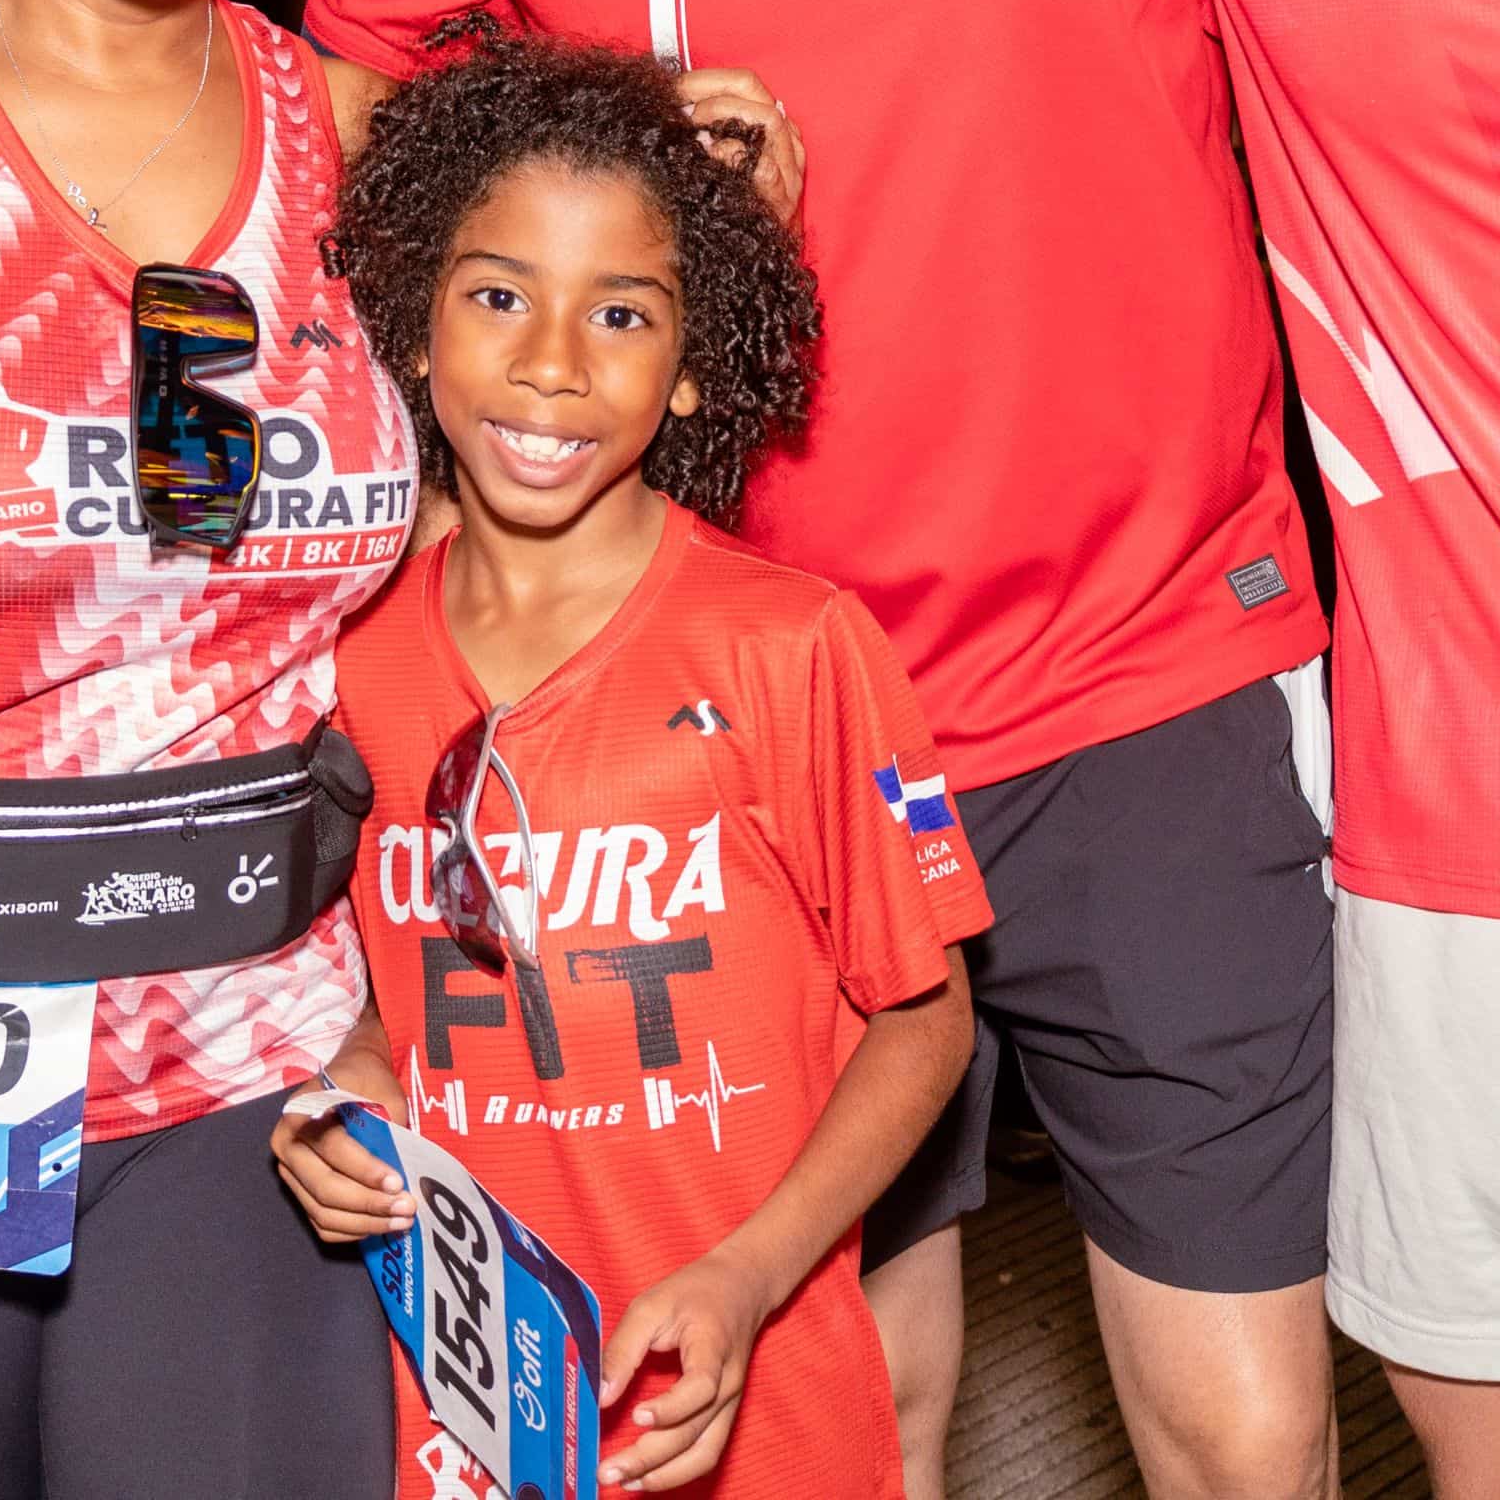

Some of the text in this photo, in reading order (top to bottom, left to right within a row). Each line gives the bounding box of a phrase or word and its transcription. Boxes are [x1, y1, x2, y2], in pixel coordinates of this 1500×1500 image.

[67, 416, 320, 489] RO
[365, 479, 412, 525] FIT
[302, 539, 345, 565] 8K
[365, 534, 400, 561] 16K
[0, 900, 59, 915] xiaomi
[128, 883, 195, 907] CLARO
[421, 932, 713, 1080] FIT
[403, 1273, 414, 1318] SANTO
[419, 1175, 497, 1432] 1549
[513, 1318, 542, 1388] ofit
[565, 1361, 578, 1425] MEDALLA
